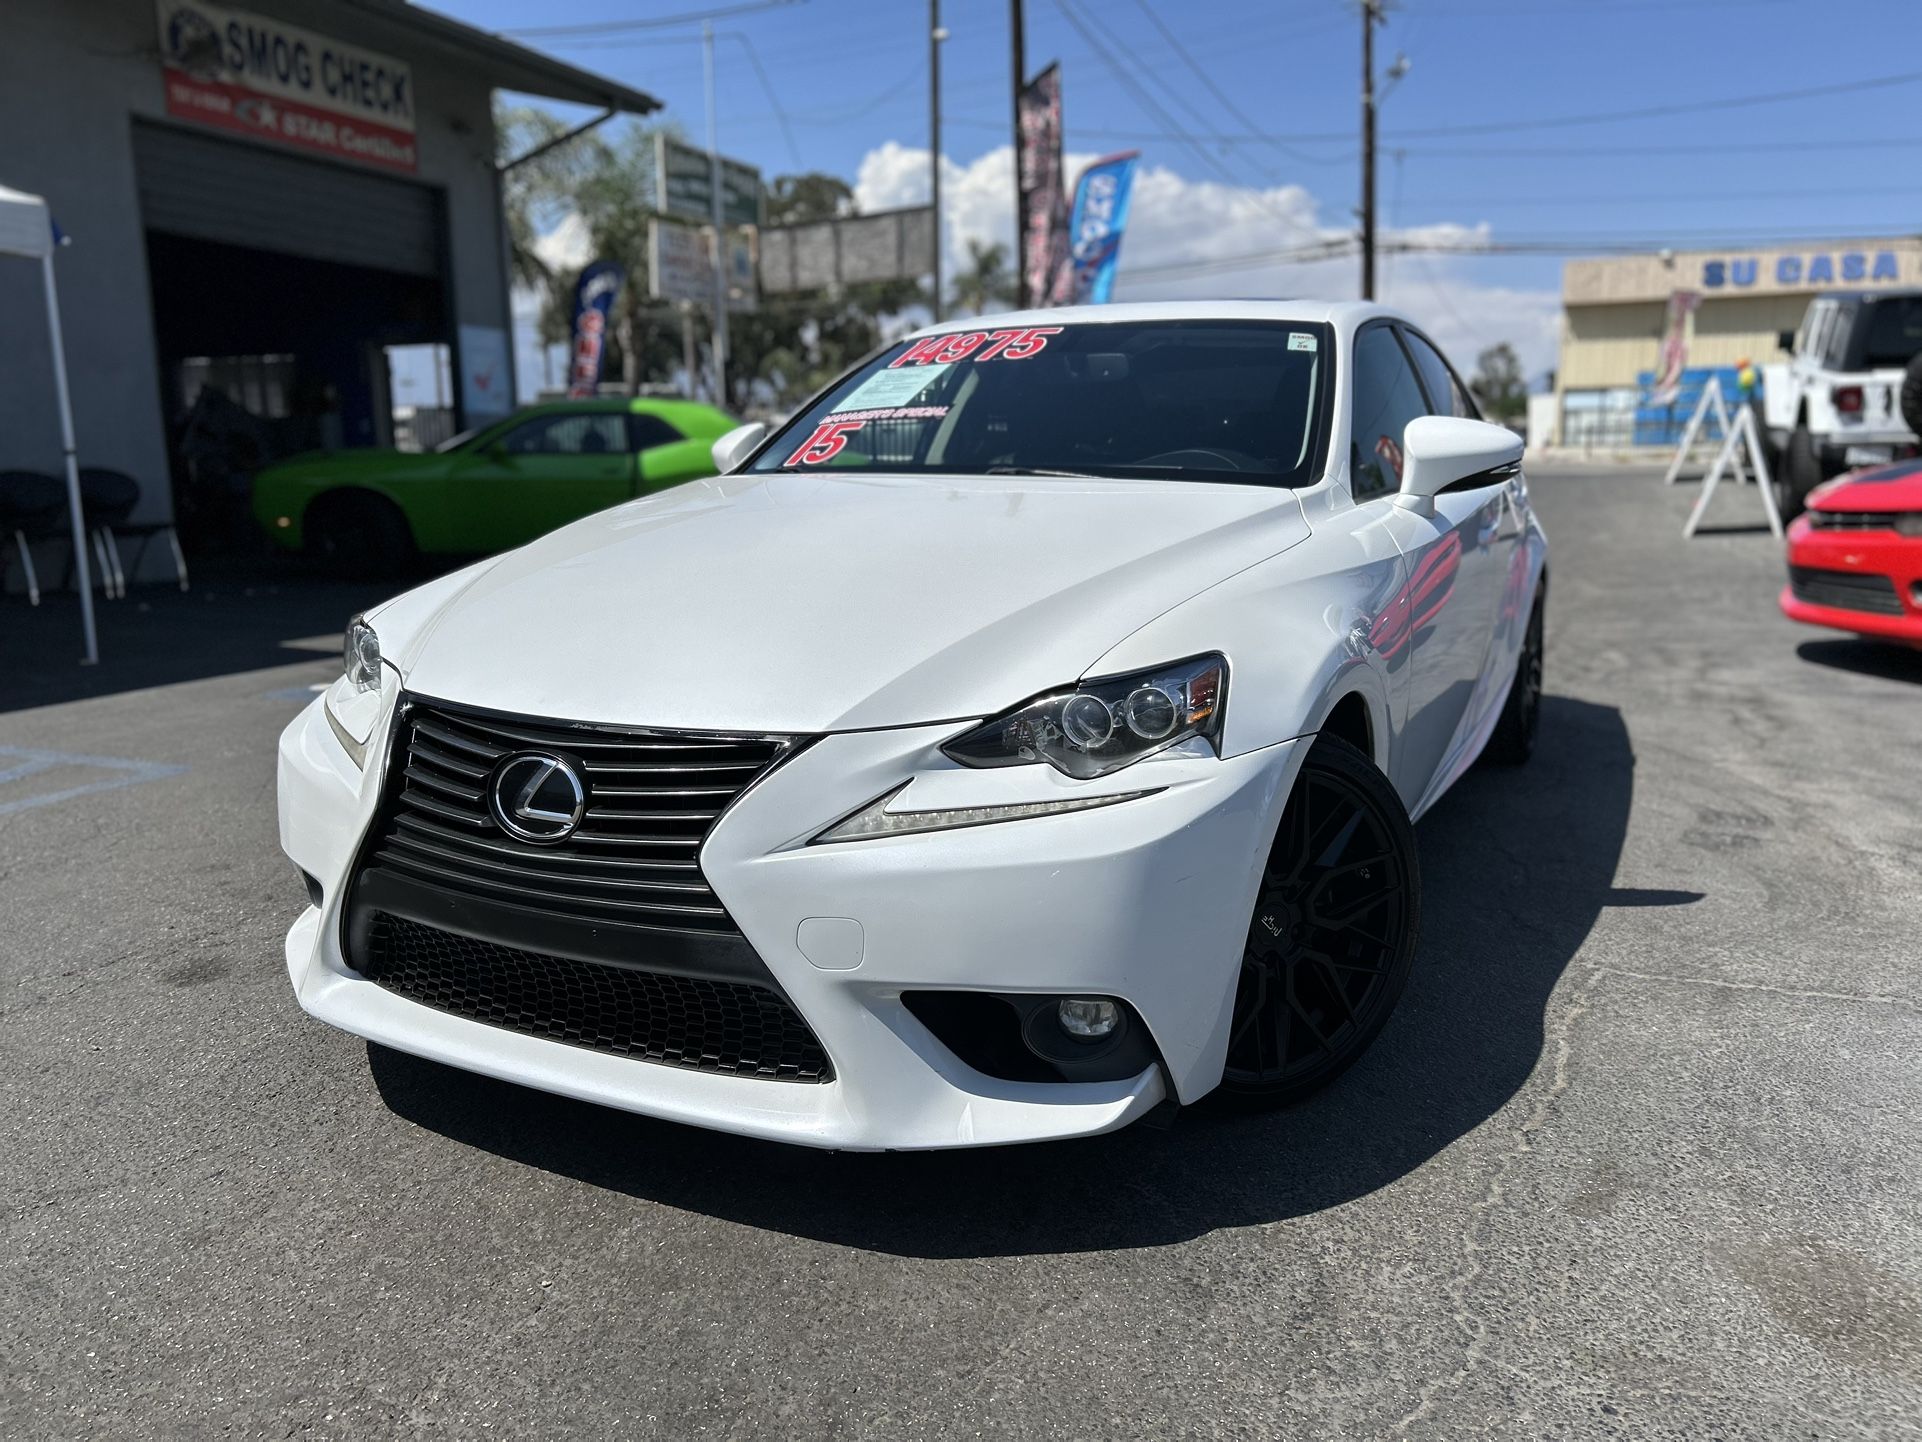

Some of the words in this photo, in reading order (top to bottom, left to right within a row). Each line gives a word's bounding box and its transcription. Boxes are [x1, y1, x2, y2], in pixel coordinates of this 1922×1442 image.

[227, 20, 313, 91] SMOG
[321, 50, 411, 119] CHECK
[282, 112, 338, 147] STAR
[1703, 257, 1758, 288] SU
[1775, 251, 1899, 284] CASA
[887, 327, 1064, 369] 14975
[783, 420, 867, 468] 15
